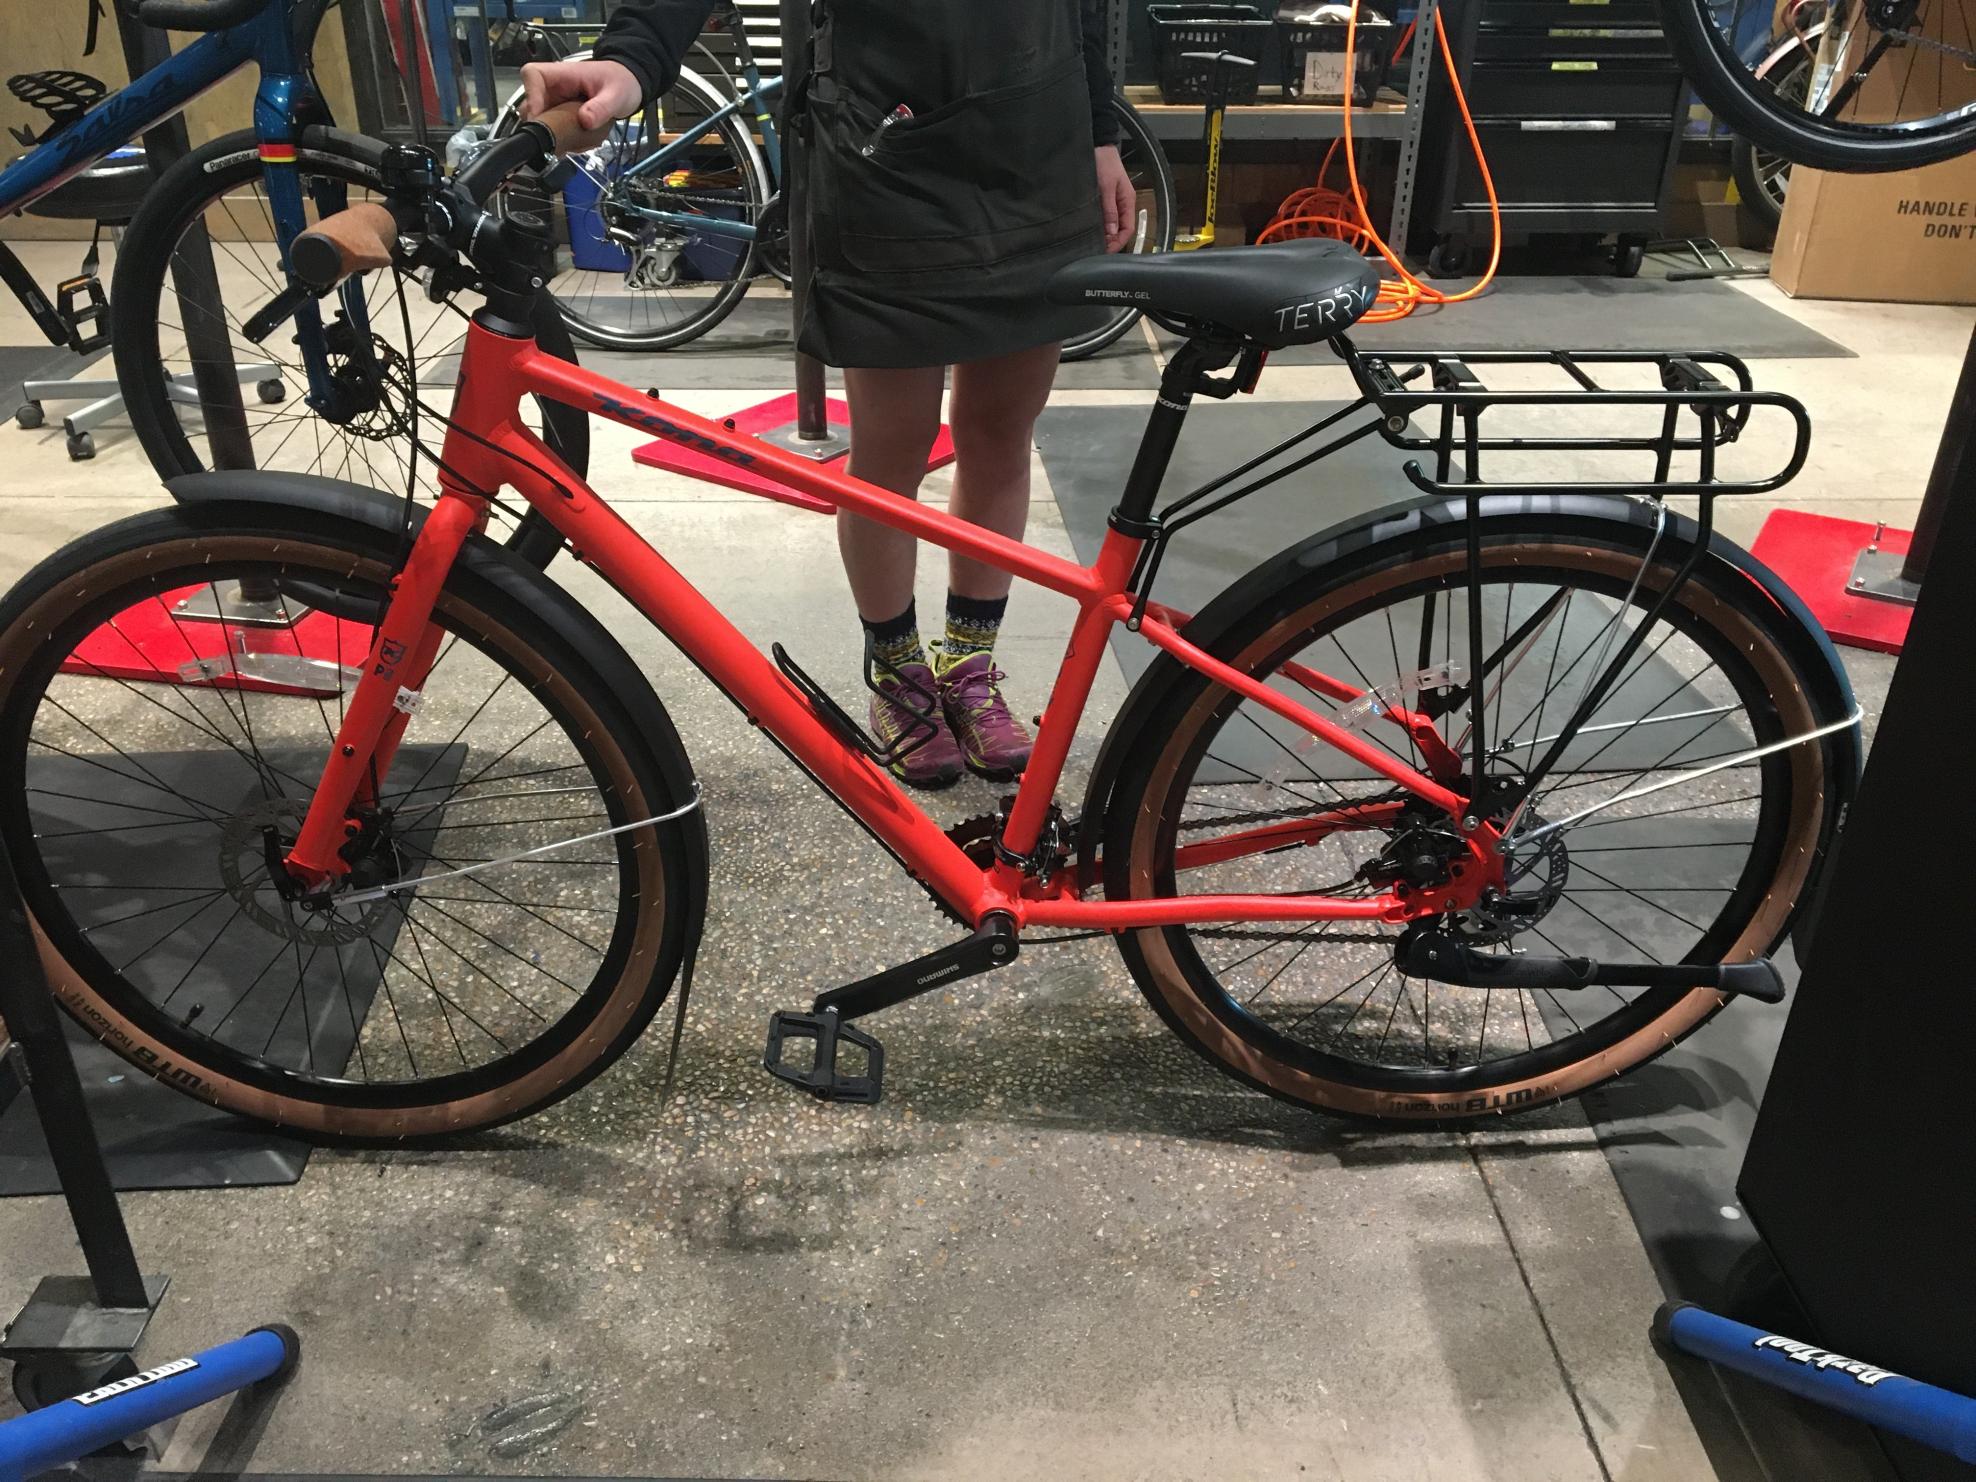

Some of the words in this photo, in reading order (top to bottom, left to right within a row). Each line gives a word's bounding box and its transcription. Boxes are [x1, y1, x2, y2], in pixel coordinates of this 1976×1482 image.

[209, 152, 250, 169] Panaracer
[1897, 199, 1969, 217] HANDLE
[1923, 223, 1976, 240] DON'T
[1134, 291, 1152, 300] GEL
[1274, 286, 1367, 333] TERRY
[916, 963, 960, 985] SHIMANO
[83, 1003, 134, 1048] horizon
[131, 1046, 203, 1089] WTB
[1466, 1088, 1533, 1113] WTB
